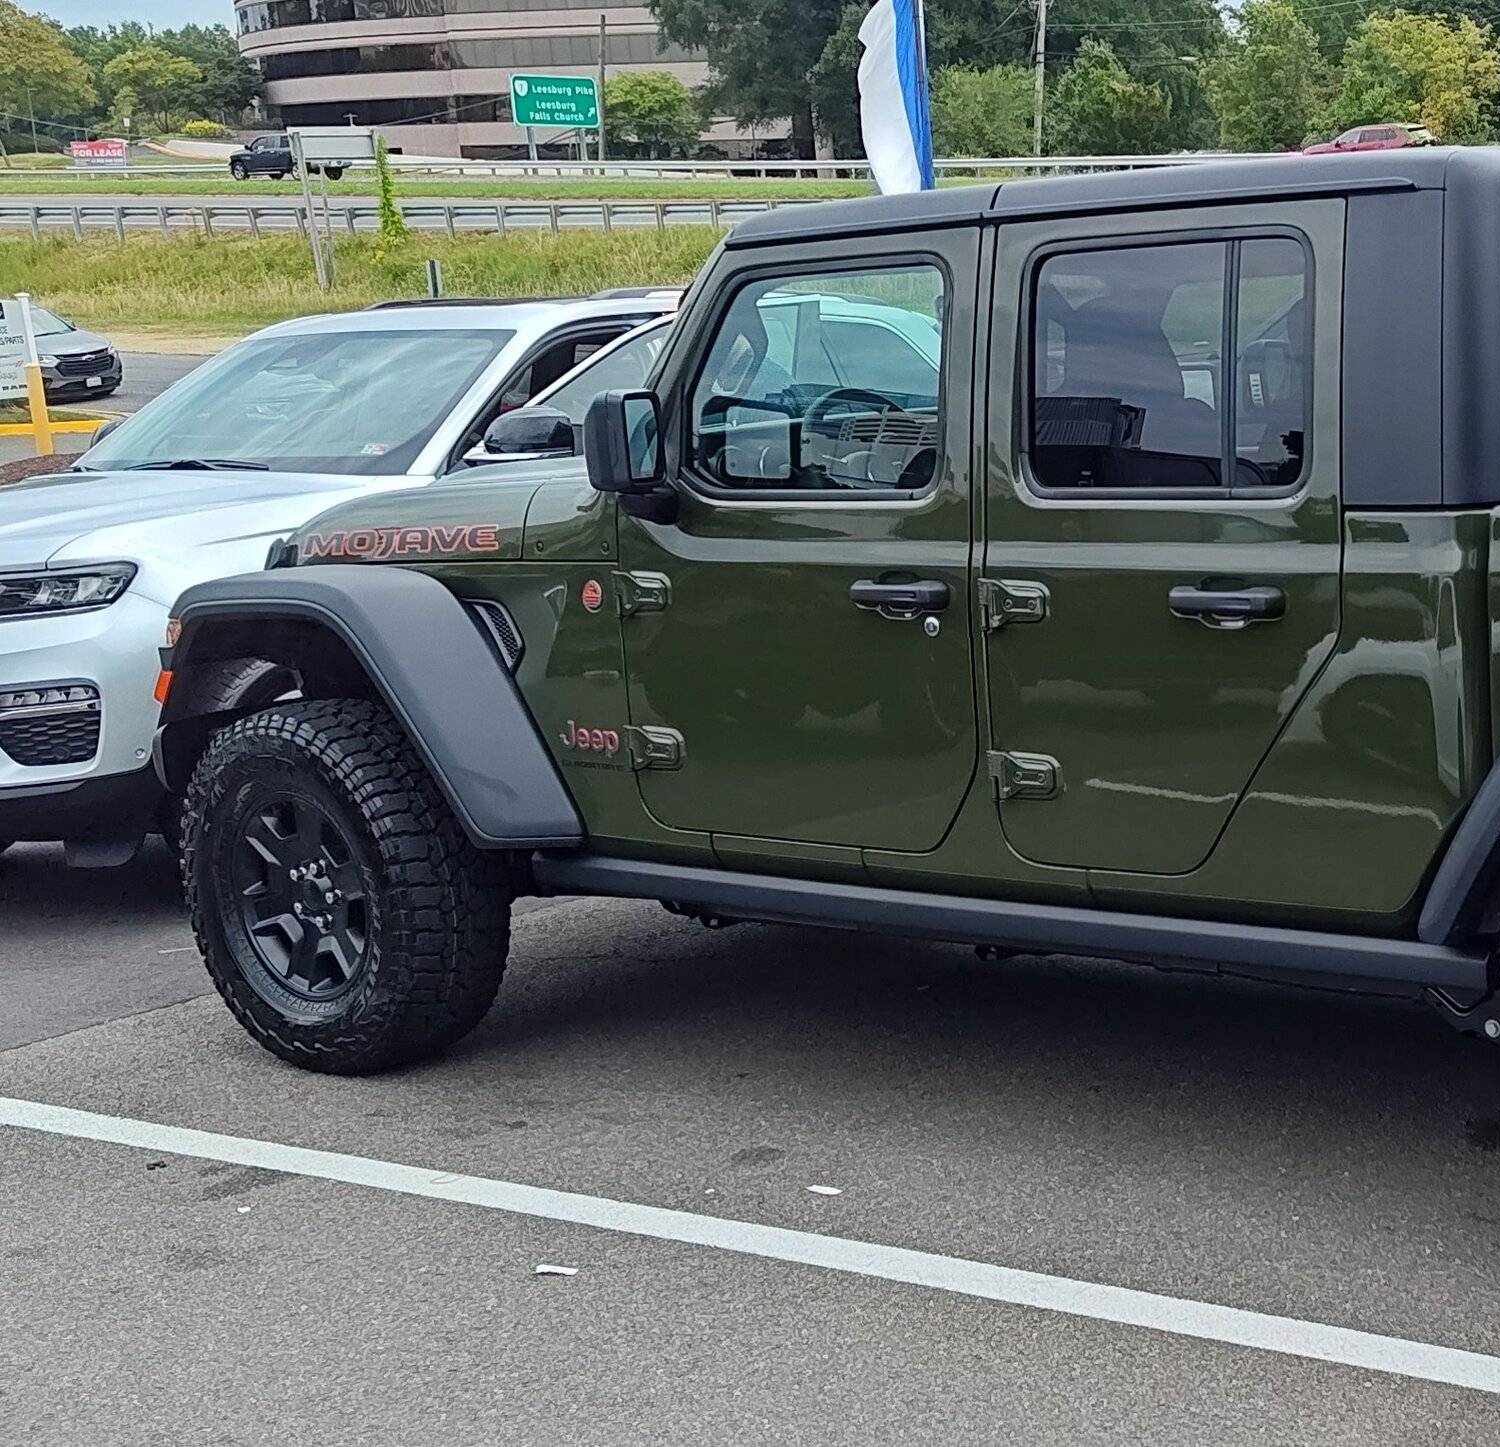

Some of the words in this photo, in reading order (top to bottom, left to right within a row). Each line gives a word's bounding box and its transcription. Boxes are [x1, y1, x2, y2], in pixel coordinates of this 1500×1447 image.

[531, 84, 572, 97] Leesburg
[575, 86, 594, 96] Pike
[536, 100, 577, 112] Leesburg
[529, 111, 551, 121] Falls
[554, 112, 585, 122] Church
[73, 149, 92, 157] FOR
[94, 149, 123, 157] LEASE
[303, 524, 500, 559] MOJAVE
[559, 719, 619, 758] Jeep
